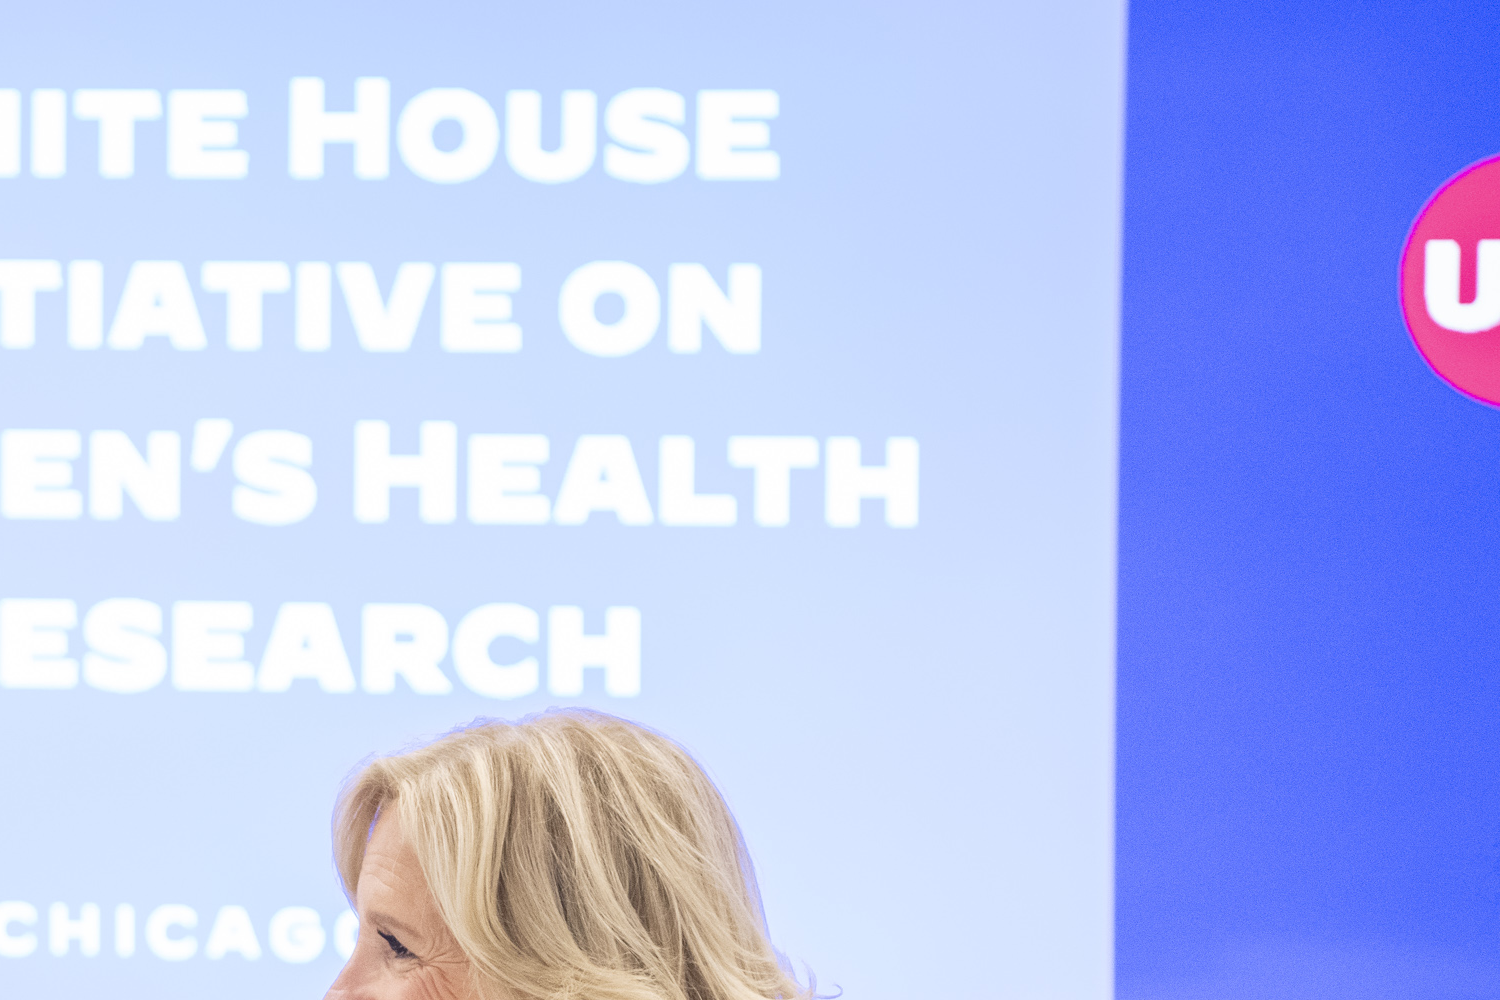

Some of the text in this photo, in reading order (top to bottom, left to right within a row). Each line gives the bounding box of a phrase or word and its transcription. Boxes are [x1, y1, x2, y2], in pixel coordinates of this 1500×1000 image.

[291, 78, 779, 182] HOUSE
[560, 262, 761, 355] ON
[356, 422, 918, 527] HEALTH
